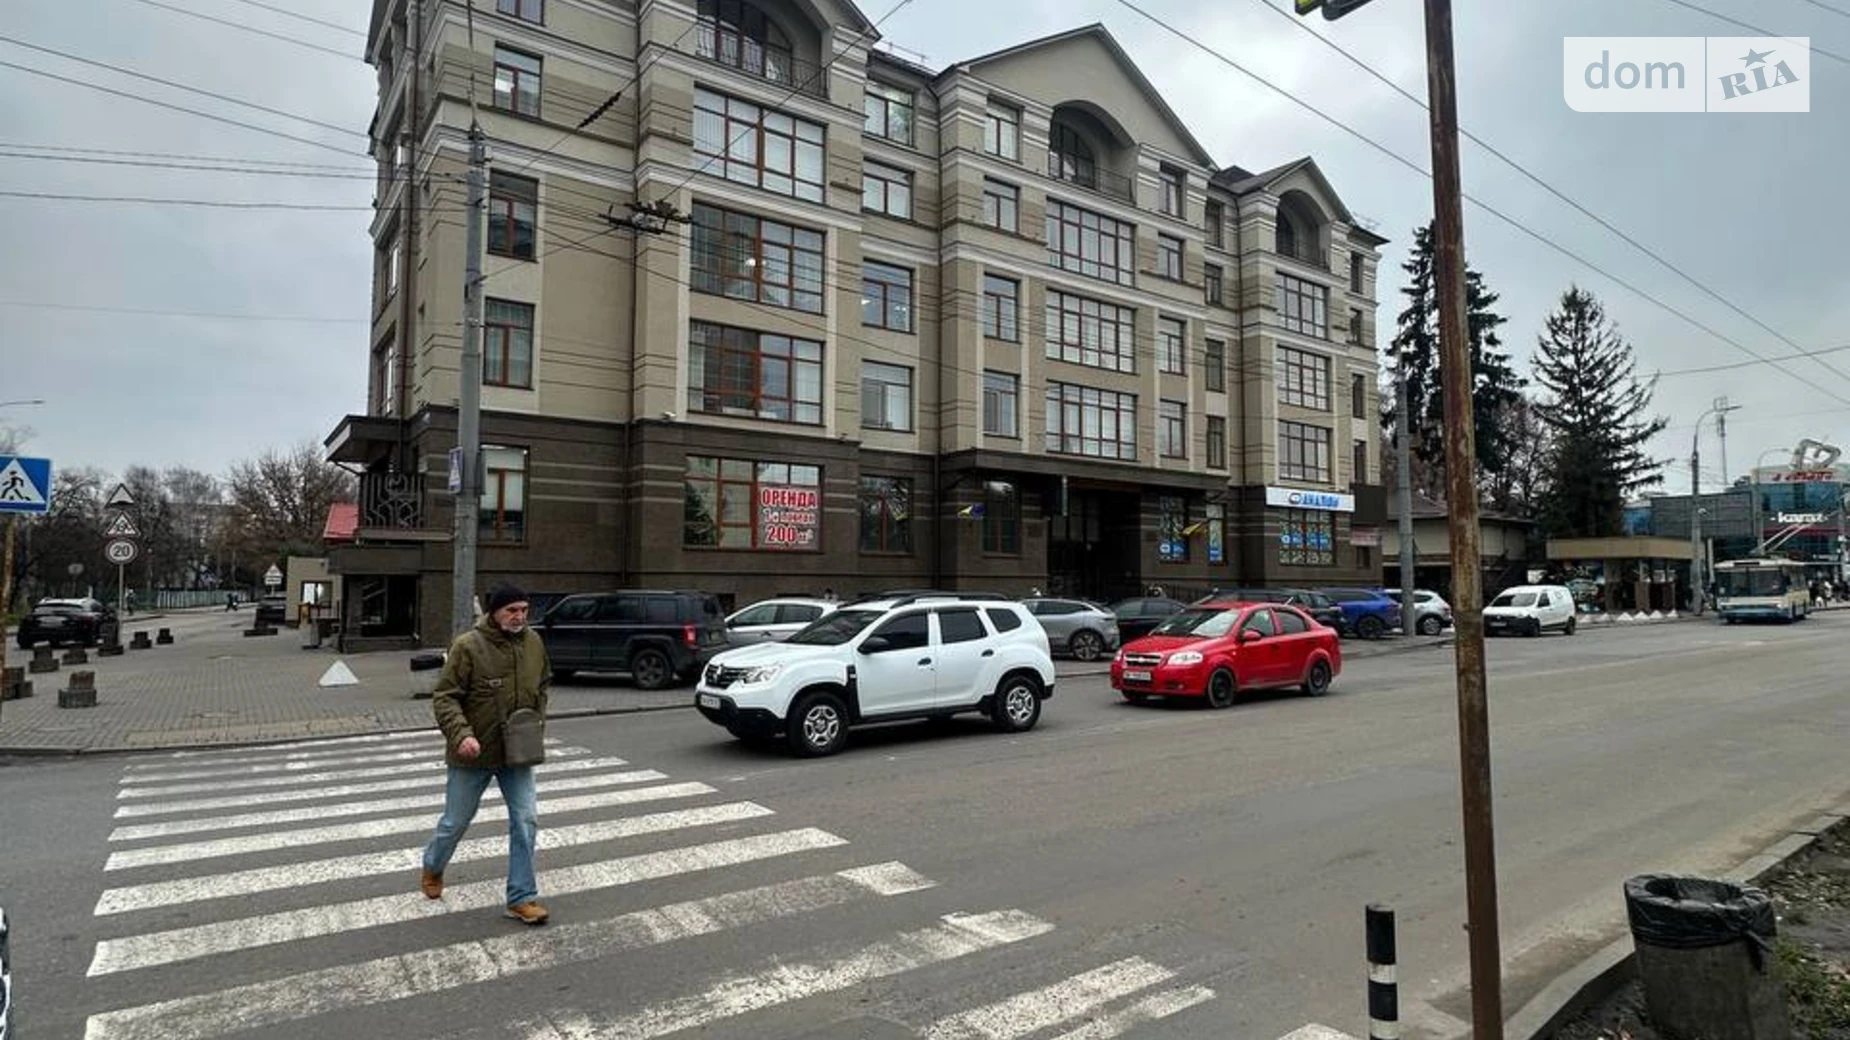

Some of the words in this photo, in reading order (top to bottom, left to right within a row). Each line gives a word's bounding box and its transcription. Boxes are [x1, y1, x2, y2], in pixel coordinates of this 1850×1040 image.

[762, 488, 817, 508] ОРЕНДА
[766, 525, 797, 542] 200
[113, 545, 130, 557] 20
